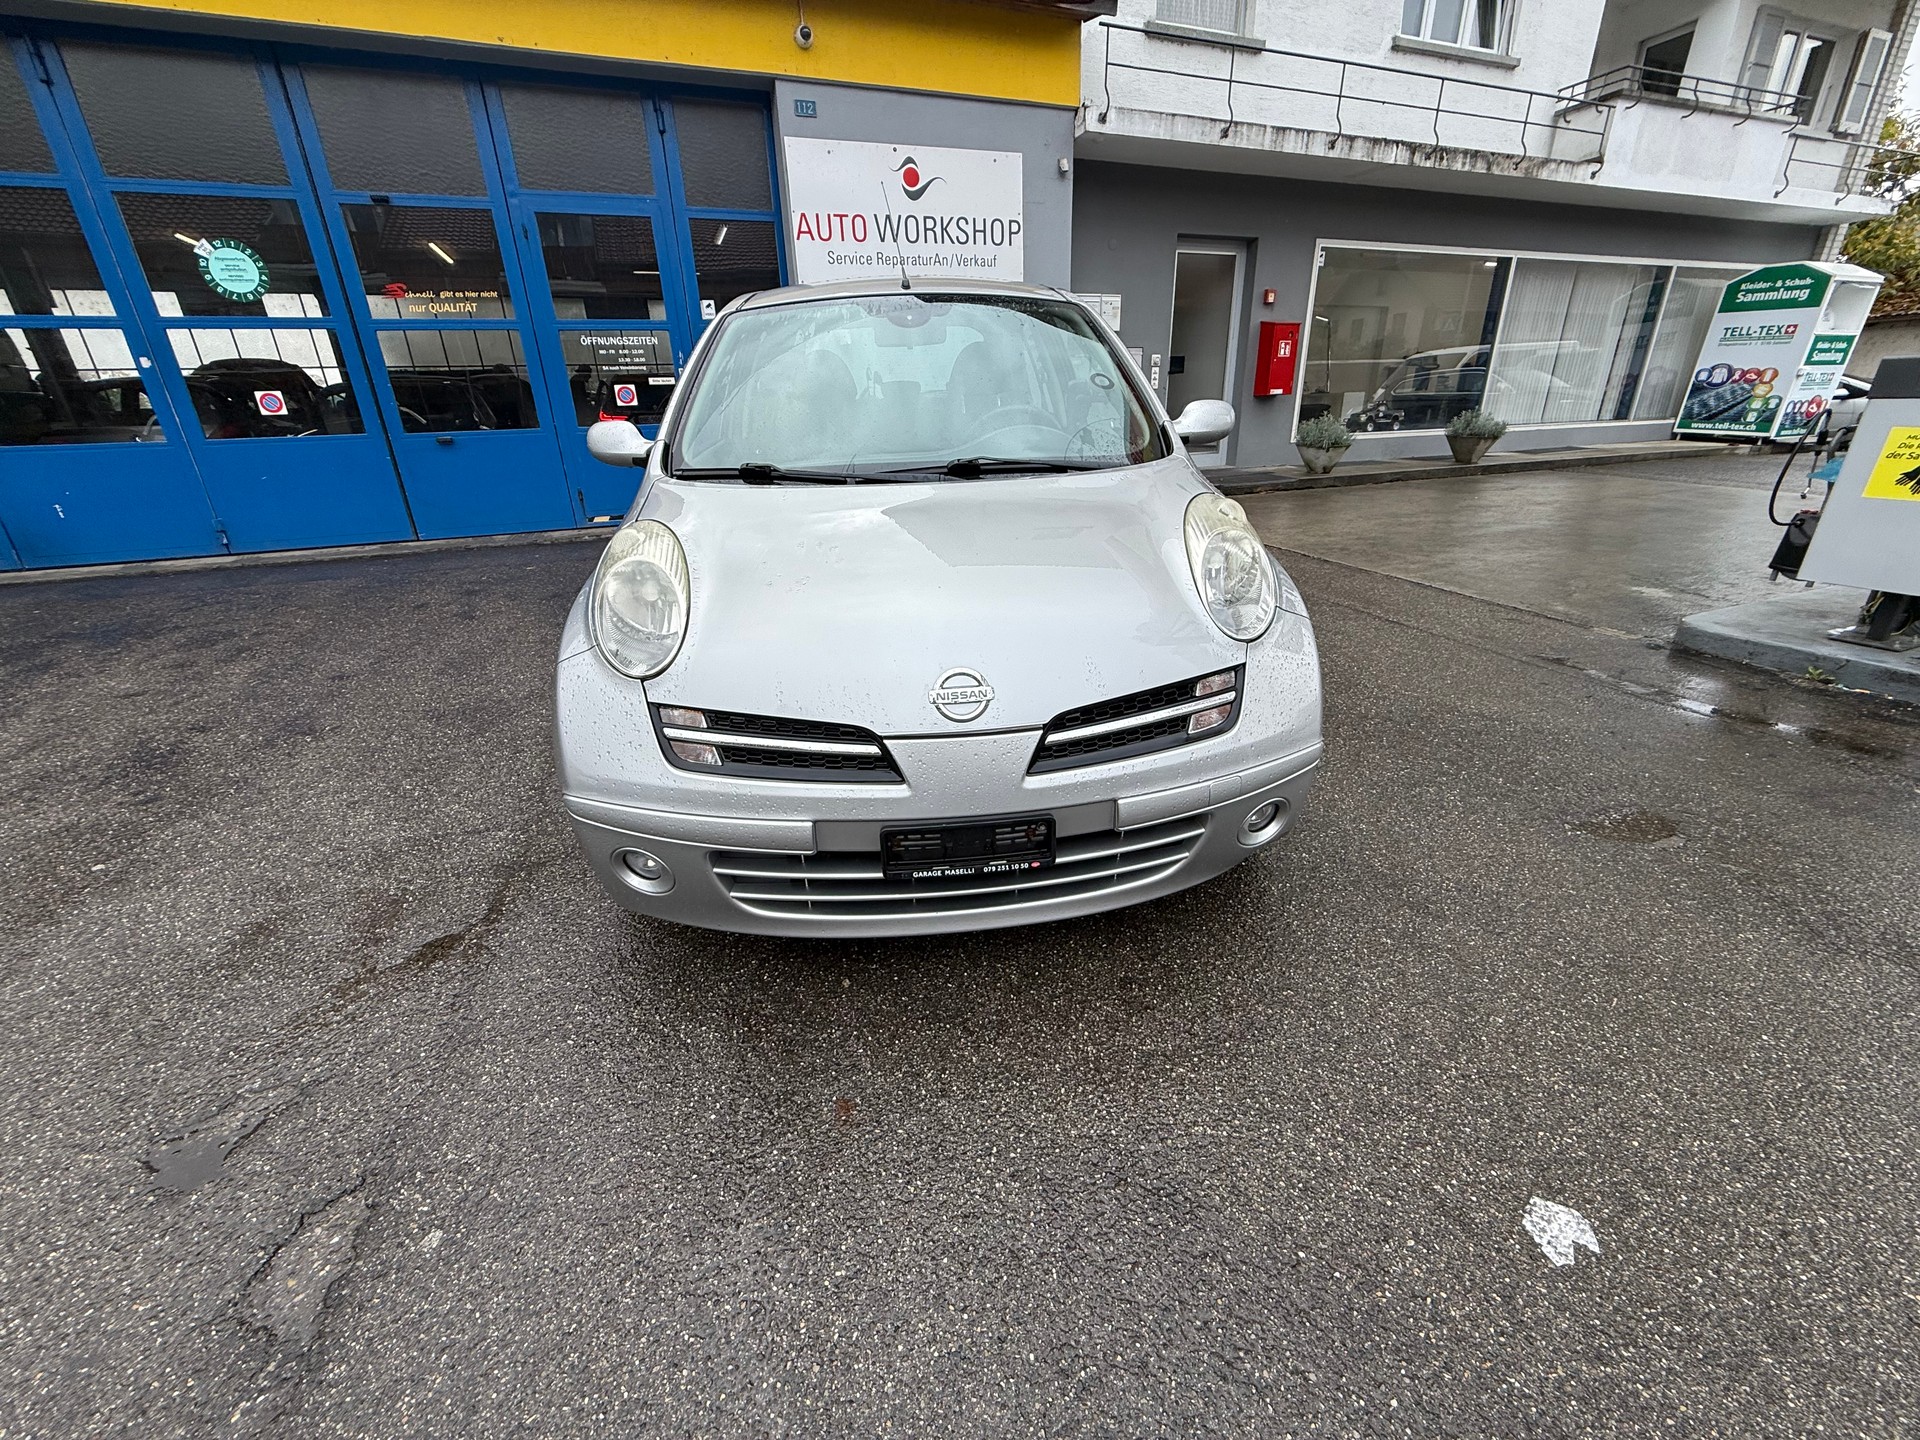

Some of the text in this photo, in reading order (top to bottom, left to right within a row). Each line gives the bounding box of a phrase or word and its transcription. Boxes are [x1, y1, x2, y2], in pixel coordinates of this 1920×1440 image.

[796, 102, 814, 114] 112
[796, 212, 1021, 246] AUTO WORKSHOP
[212, 240, 222, 248] 12
[198, 258, 207, 266] 10
[827, 250, 873, 266] Service
[1740, 280, 1773, 290] Kleider-
[1785, 277, 1814, 286] Schuh-
[439, 290, 454, 299] gibt
[1736, 288, 1810, 302] Sammlung
[428, 301, 477, 313] QUALITÄT
[1723, 324, 1785, 337] TELL-TEX
[580, 335, 658, 345] ÖFFNUNGSZEITEN
[1811, 350, 1844, 363] Sammlung
[1691, 422, 1757, 431] www.tell-tex.ch
[1886, 451, 1906, 459] der
[936, 690, 988, 700] NISSAN
